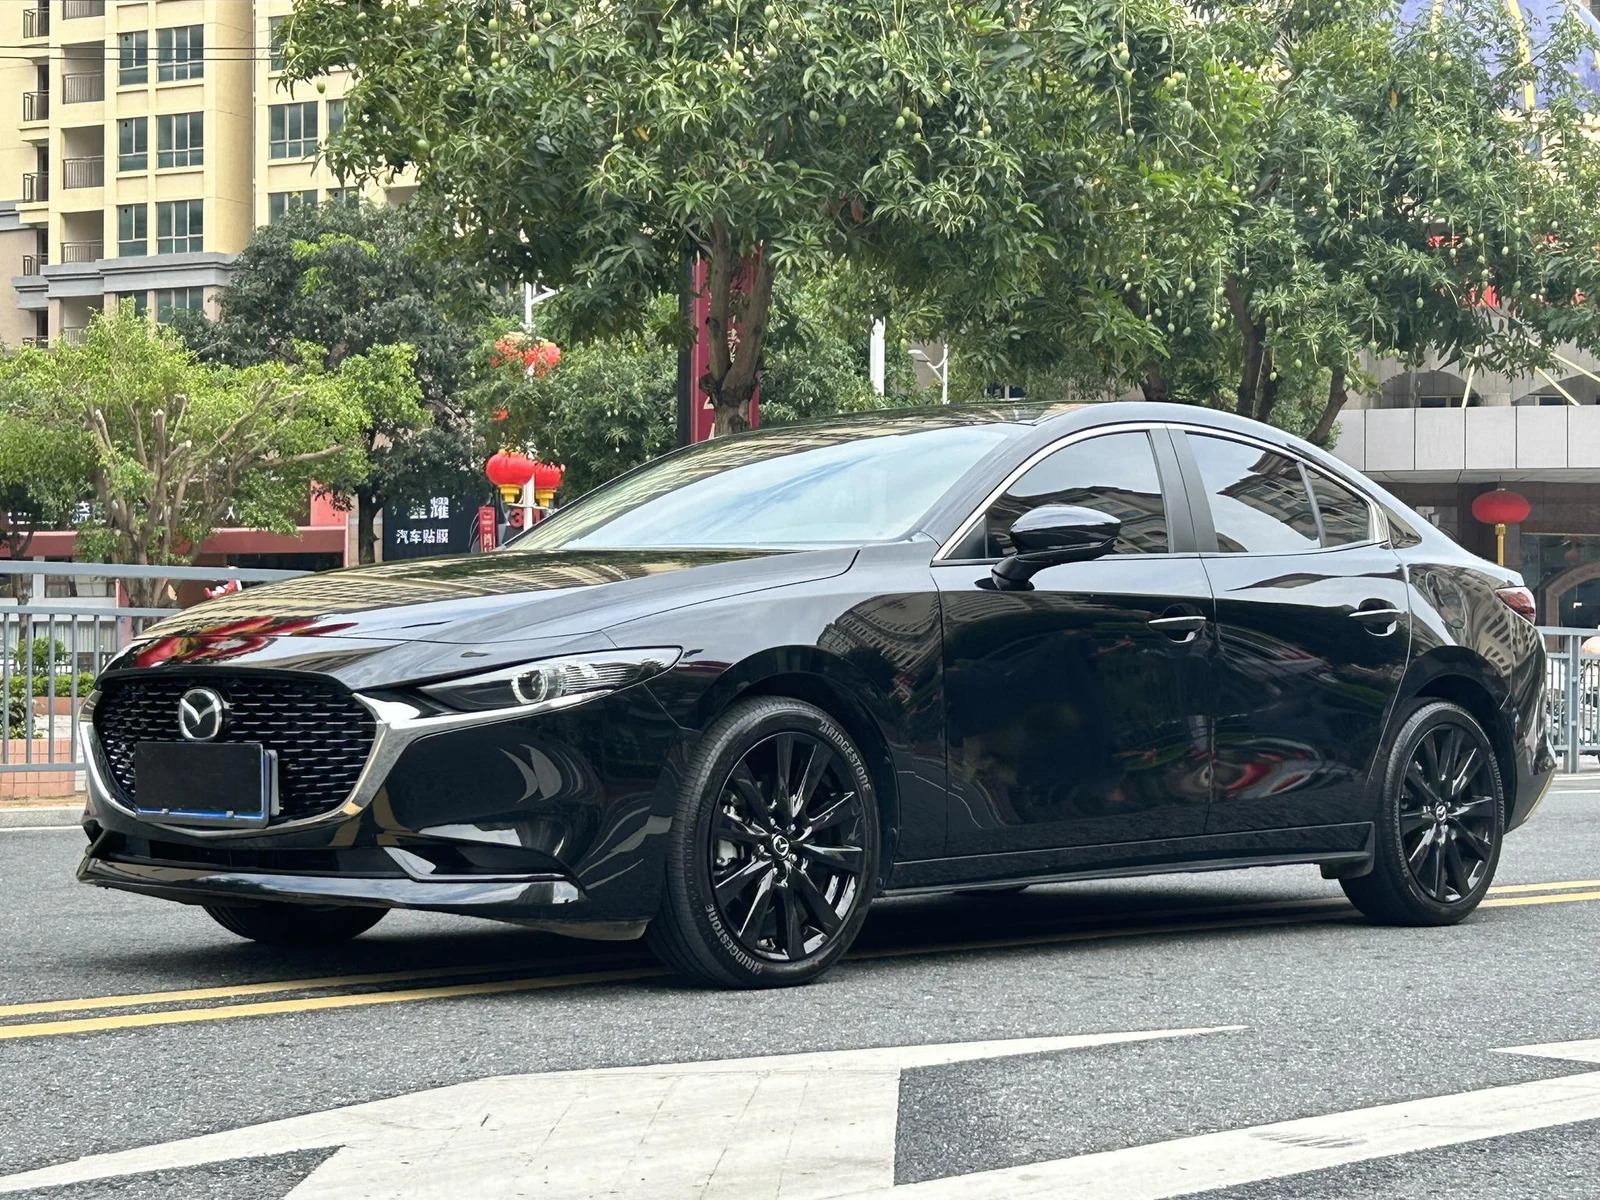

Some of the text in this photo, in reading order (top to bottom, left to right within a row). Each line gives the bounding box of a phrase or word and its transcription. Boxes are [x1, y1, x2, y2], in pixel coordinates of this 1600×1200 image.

[396, 529, 449, 544] 汽车贴膜
[818, 720, 871, 791] BRIDGESTONE
[705, 903, 763, 975] BRIDGESTONE
